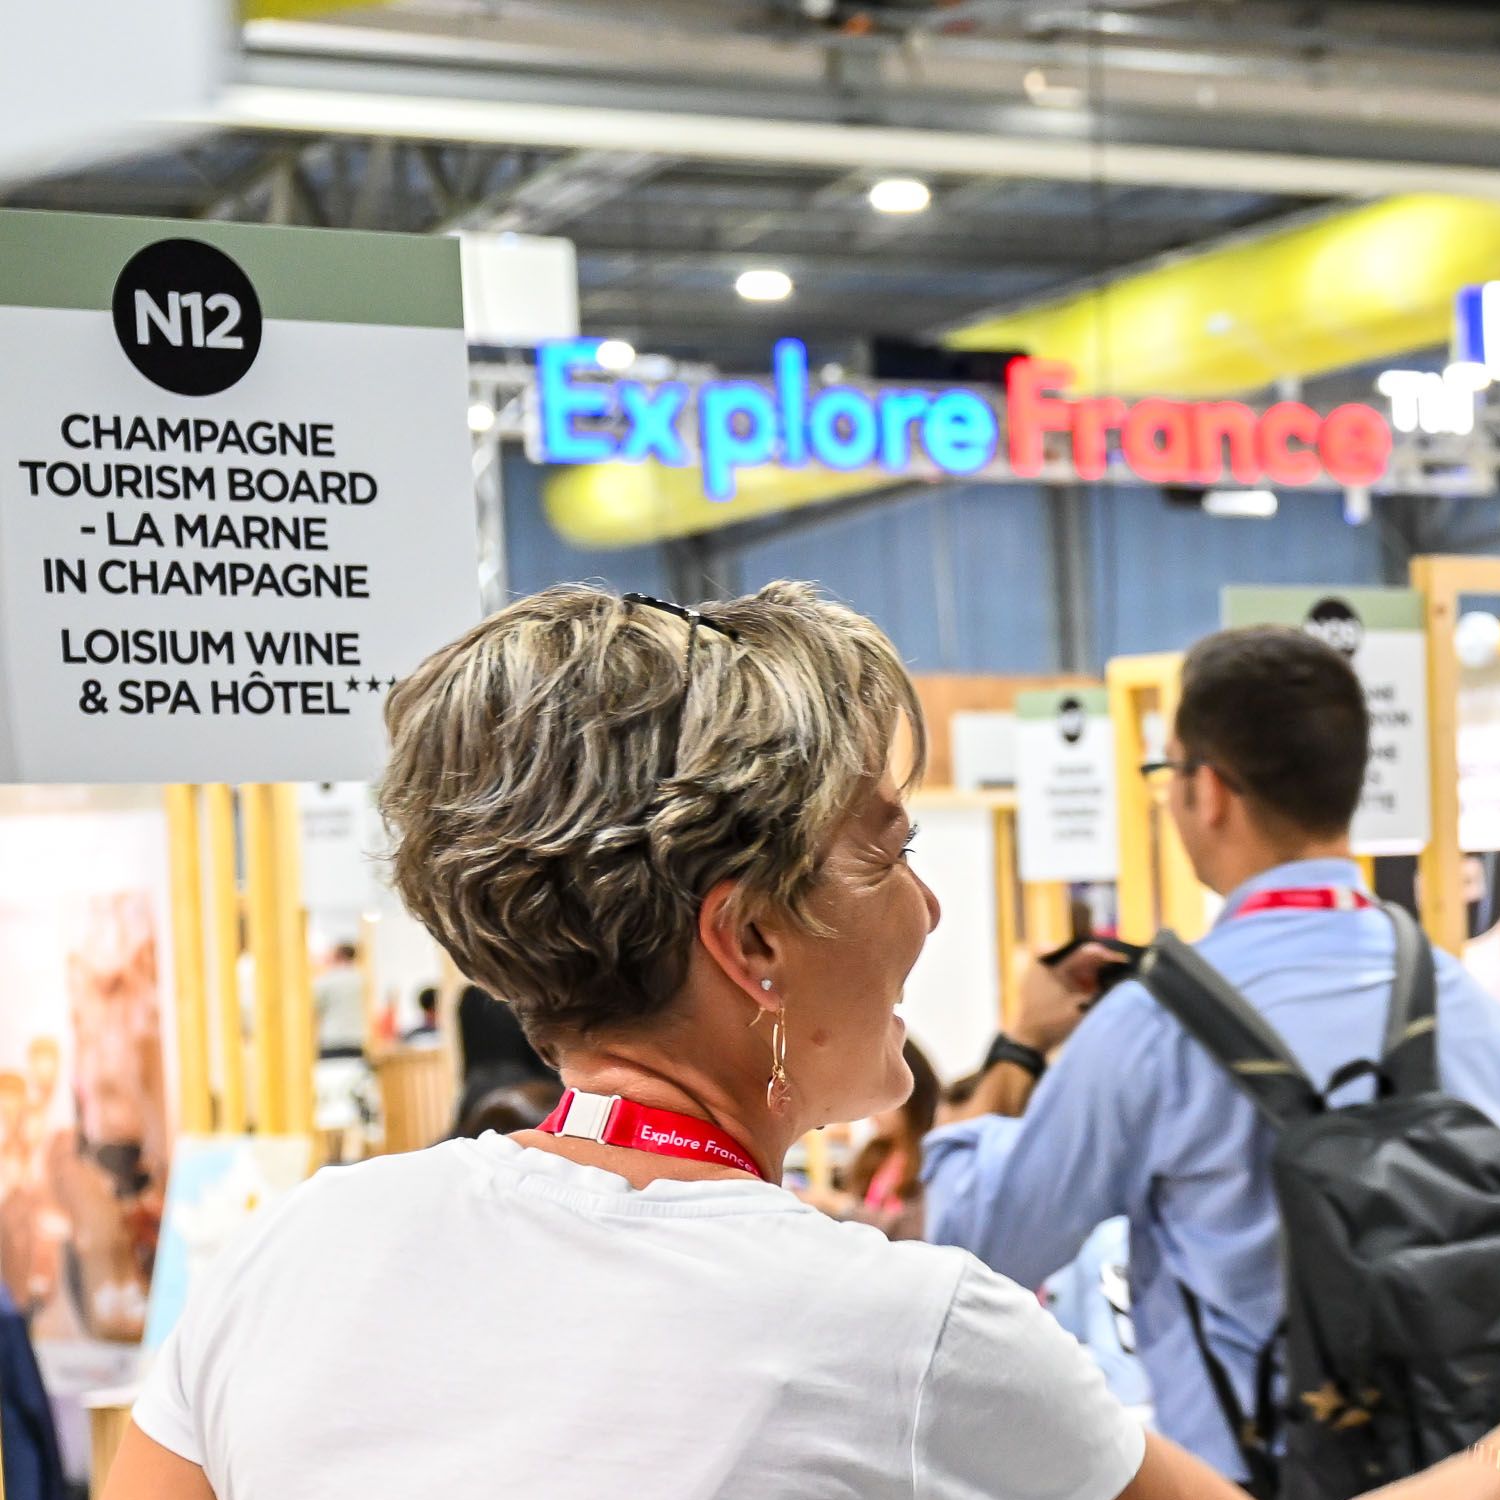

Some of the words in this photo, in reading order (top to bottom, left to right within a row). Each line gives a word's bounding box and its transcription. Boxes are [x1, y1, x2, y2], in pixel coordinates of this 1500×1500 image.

[134, 289, 245, 349] N12
[61, 413, 336, 458] CHAMPAGNE
[536, 336, 997, 500] Explore
[1006, 355, 1393, 486] France
[18, 460, 216, 501] TOURISM
[228, 467, 378, 505] BOARD
[106, 511, 165, 547] LA
[174, 513, 329, 551] MARNE
[43, 558, 87, 594] IN
[99, 560, 370, 599] CHAMPAGNE
[60, 628, 235, 665] LOISIUM
[245, 631, 361, 665] WINE
[78, 679, 109, 715] &
[118, 680, 200, 715] SPA
[640, 1124, 702, 1151] Explore
